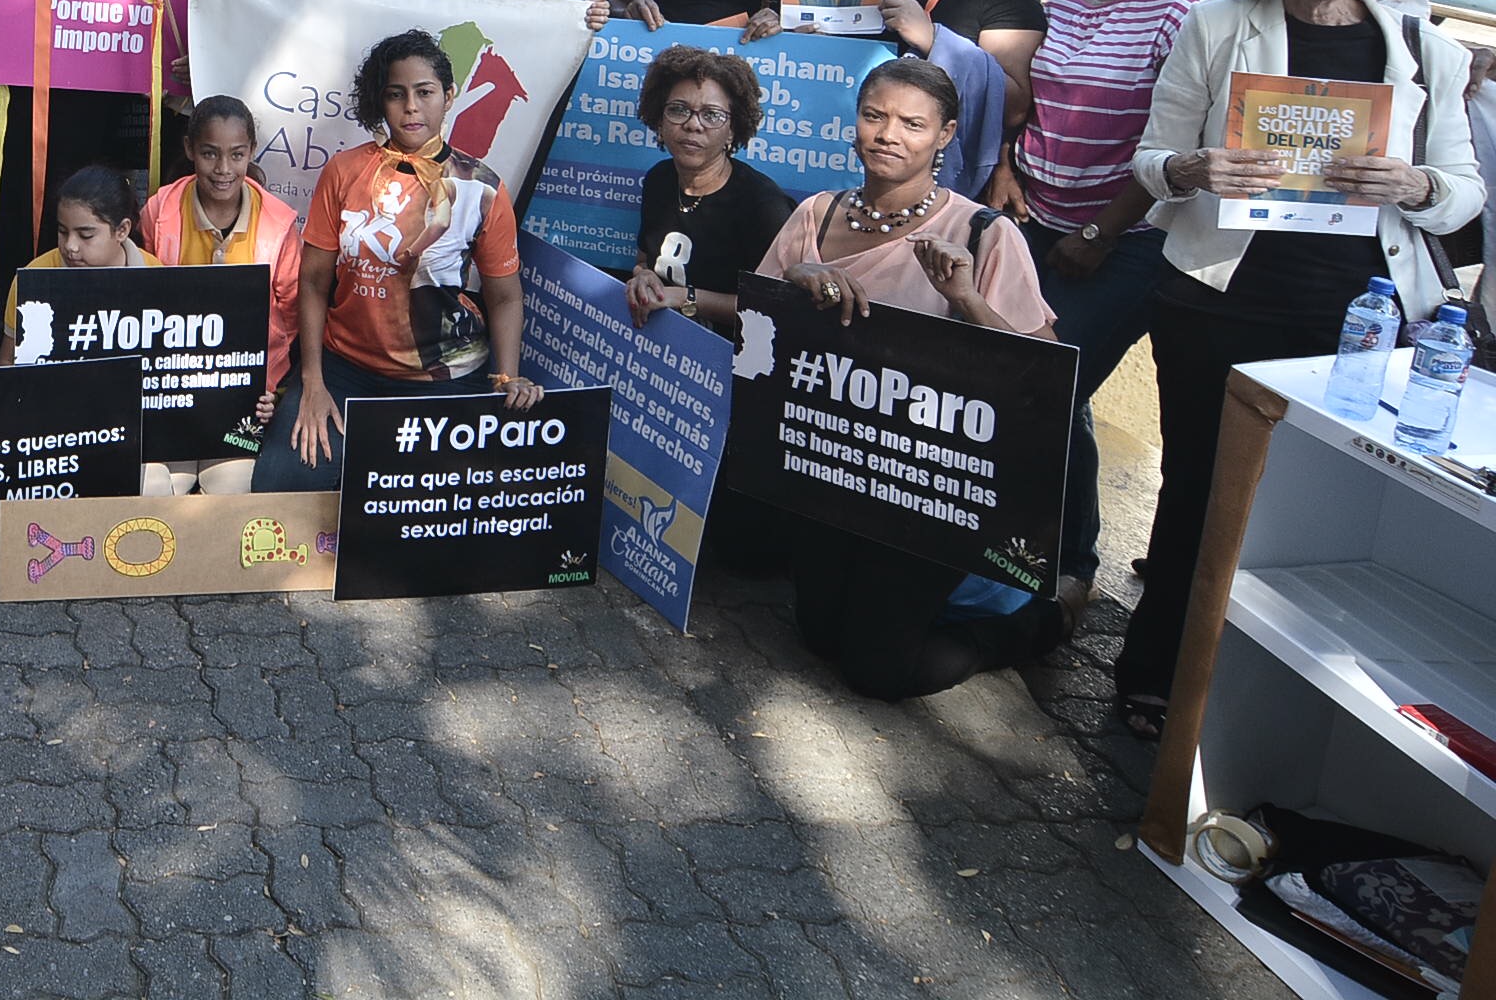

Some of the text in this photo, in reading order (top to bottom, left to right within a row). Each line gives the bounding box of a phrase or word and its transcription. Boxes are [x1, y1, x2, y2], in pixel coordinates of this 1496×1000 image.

[127, 3, 153, 26] yo
[54, 25, 144, 54] importo
[588, 36, 653, 64] Dios
[1257, 117, 1354, 138] SOCIALES
[1258, 104, 1355, 124] LAS DEUDAS
[1267, 132, 1342, 150] DEL PAÍS
[1295, 148, 1334, 163] LAS
[268, 181, 298, 197] cada
[562, 165, 635, 187] el próximo
[581, 183, 601, 199] los
[353, 282, 387, 299] 2018
[68, 308, 224, 351] #YoParo
[532, 269, 724, 398] la misma manera que la Biblia
[155, 353, 203, 371] calidez
[205, 355, 214, 371] y
[215, 351, 265, 368] calidad
[562, 319, 715, 428] y exalta a las mujeres,
[162, 372, 179, 388] de
[181, 371, 219, 388] salud
[220, 372, 251, 388] para
[530, 316, 710, 451] la sociedad debe ser más
[789, 350, 996, 443] #YoParo
[17, 426, 126, 455] queremos:
[223, 433, 260, 453] MOVIDA
[395, 414, 566, 453] #YoParo
[632, 414, 704, 476] derechos
[784, 401, 994, 479] porque se me paguen
[18, 455, 80, 479] LIBRES
[367, 461, 587, 491] Para que las escuelas
[779, 422, 997, 508] las horas extras en las
[364, 484, 585, 515] asuman la educación
[784, 450, 980, 531] jornadas laborables
[400, 513, 553, 539] sexual integral.
[611, 525, 679, 597] Cristiana
[626, 526, 677, 575] ALIANZA
[548, 571, 590, 584] MOVIDA
[984, 547, 1043, 592] MOVIDA
